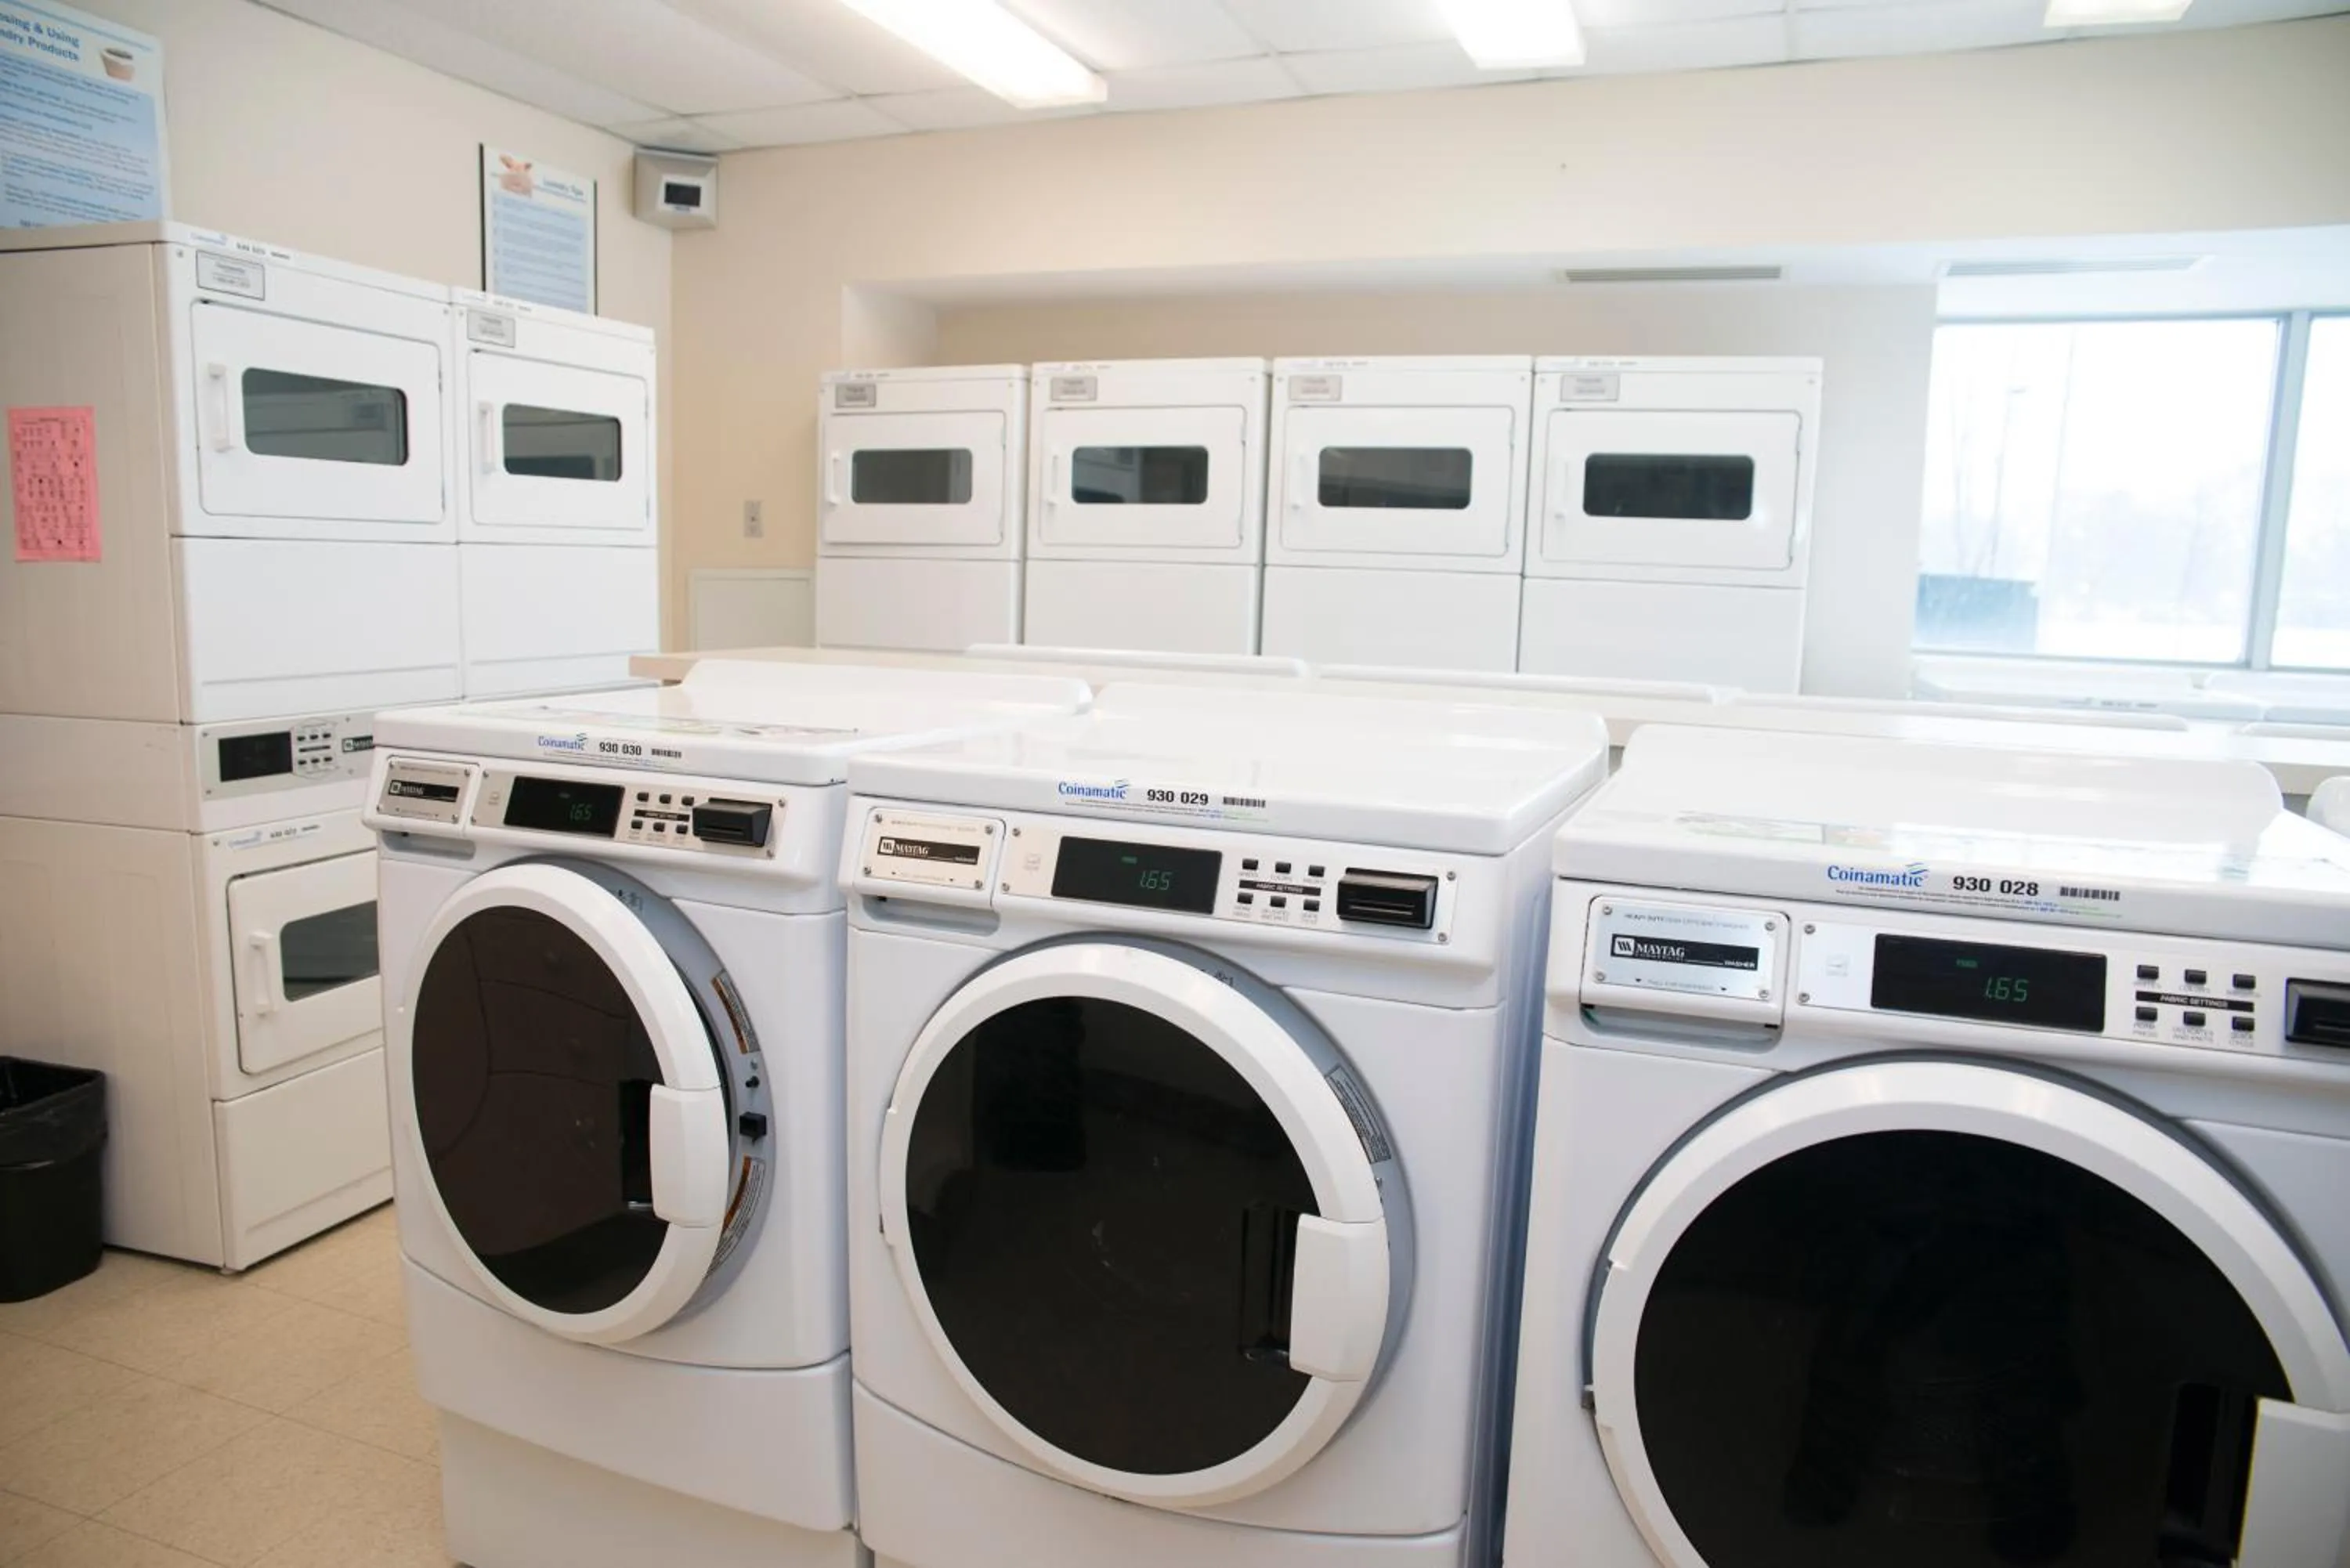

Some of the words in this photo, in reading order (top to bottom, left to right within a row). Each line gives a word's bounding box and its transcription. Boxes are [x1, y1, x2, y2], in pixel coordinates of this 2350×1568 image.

[34, 22, 43, 34] &
[47, 26, 80, 49] Using
[28, 35, 79, 61] Products
[538, 735, 584, 751] Coinamatic
[599, 742, 618, 753] 930
[622, 744, 642, 756] 030
[1058, 781, 1126, 800] Coinamatic
[1147, 789, 1174, 803] 930
[1180, 792, 1209, 806] 029
[895, 844, 928, 854] MAYTAG
[1828, 865, 1924, 887] Coinamatic
[1953, 876, 1991, 892] 930
[1999, 880, 2040, 897] 028
[1636, 942, 1685, 957] MAYTAG
[1724, 960, 1755, 969] WASHER
[2160, 995, 2188, 1003] FABRIC
[2189, 997, 2229, 1008] SETTINGS
